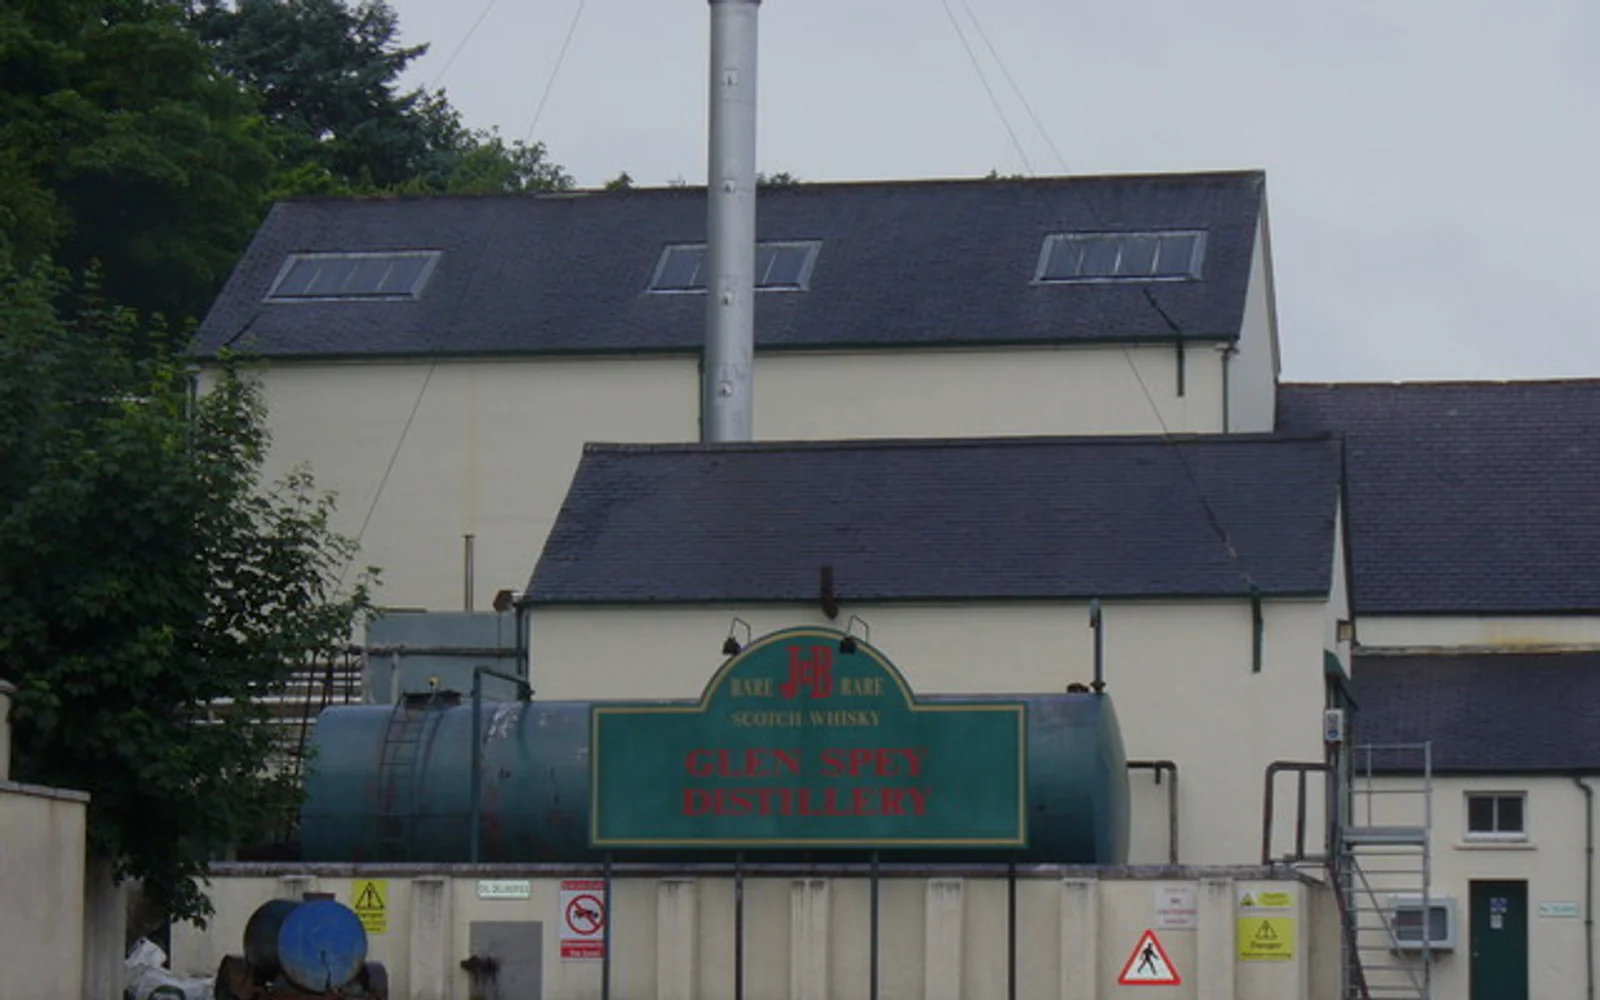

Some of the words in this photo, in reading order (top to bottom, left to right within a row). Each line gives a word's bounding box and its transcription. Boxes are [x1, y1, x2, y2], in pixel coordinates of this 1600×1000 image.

[730, 677, 774, 697] RARE
[840, 677, 885, 697] RARE
[731, 710, 802, 728] SCOTCH
[809, 709, 882, 727] WHISKY
[684, 747, 799, 778] GLEN
[820, 747, 929, 777] SPEY
[681, 786, 932, 817] DISTILLERY
